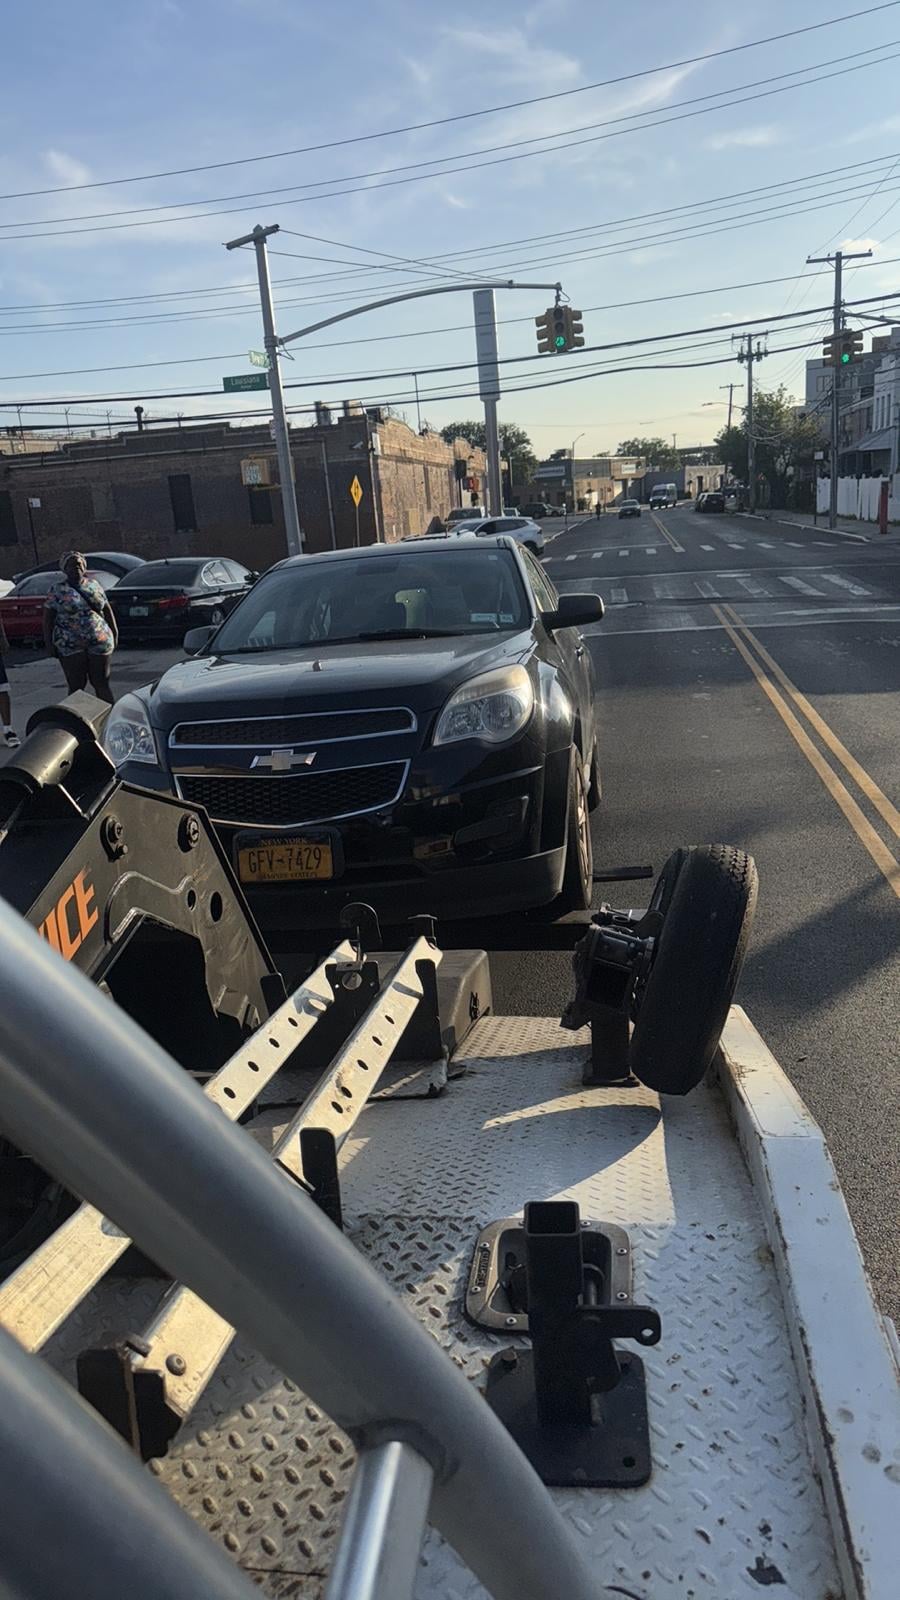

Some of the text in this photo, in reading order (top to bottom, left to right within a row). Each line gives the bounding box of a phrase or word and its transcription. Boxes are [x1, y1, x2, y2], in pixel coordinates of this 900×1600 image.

[260, 837, 307, 847] NEW YORK
[38, 865, 99, 961] ICE
